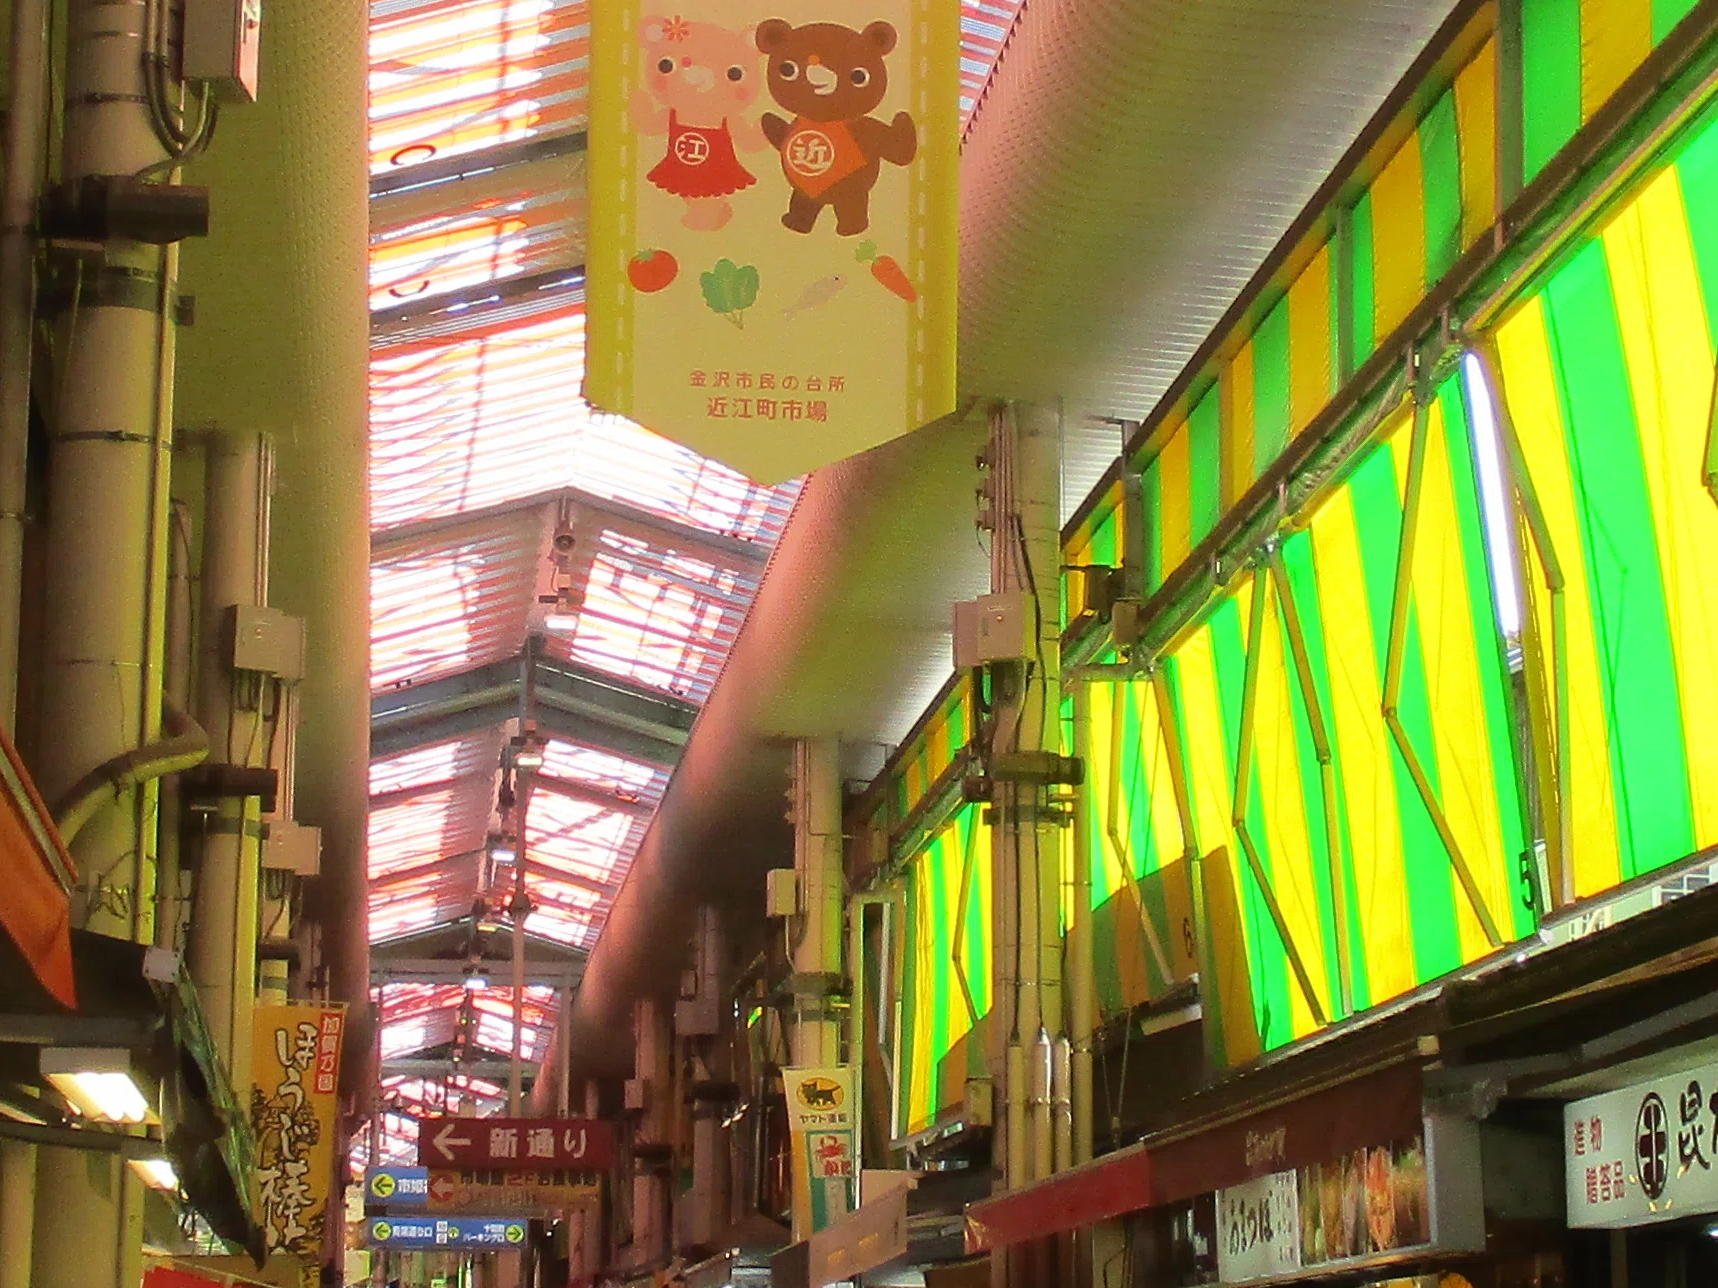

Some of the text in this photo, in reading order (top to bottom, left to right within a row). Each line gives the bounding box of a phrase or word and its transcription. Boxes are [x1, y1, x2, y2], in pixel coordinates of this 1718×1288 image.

[793, 137, 832, 170] 近
[689, 369, 847, 393] 金沢市民の台所
[706, 396, 829, 424] 近江町市場
[489, 1126, 588, 1160] 新通り
